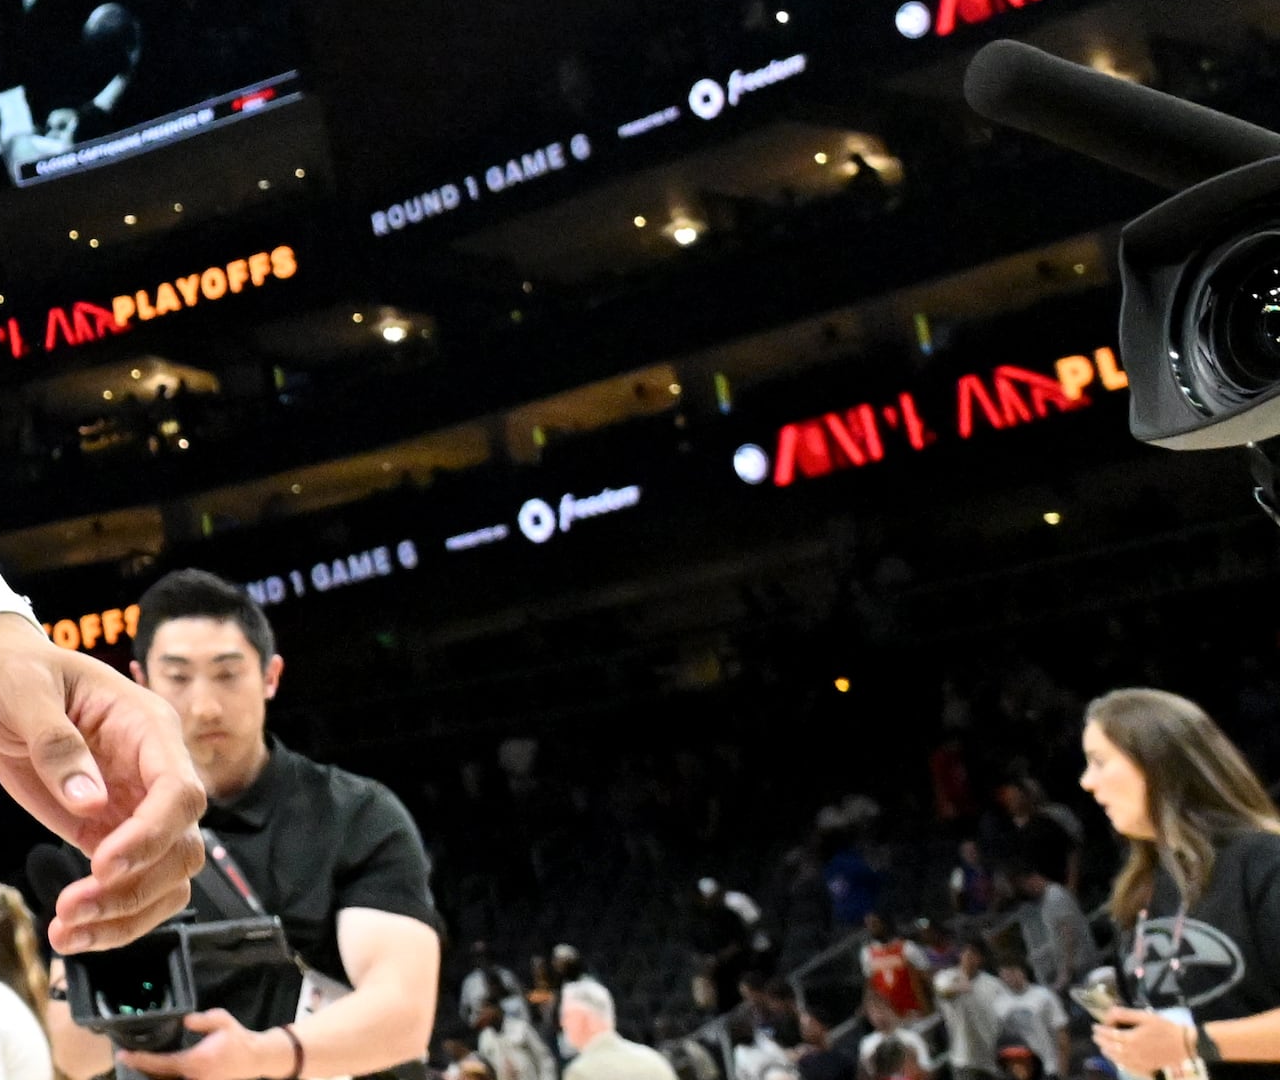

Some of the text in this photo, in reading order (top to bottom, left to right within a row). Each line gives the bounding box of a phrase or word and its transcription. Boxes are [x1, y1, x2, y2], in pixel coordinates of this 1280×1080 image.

[370, 183, 460, 237] ROUND
[463, 176, 479, 201] 1
[485, 143, 567, 193] GAME
[112, 245, 298, 328] PLAYOFFS
[289, 570, 306, 598] 1
[311, 544, 392, 593] GAME
